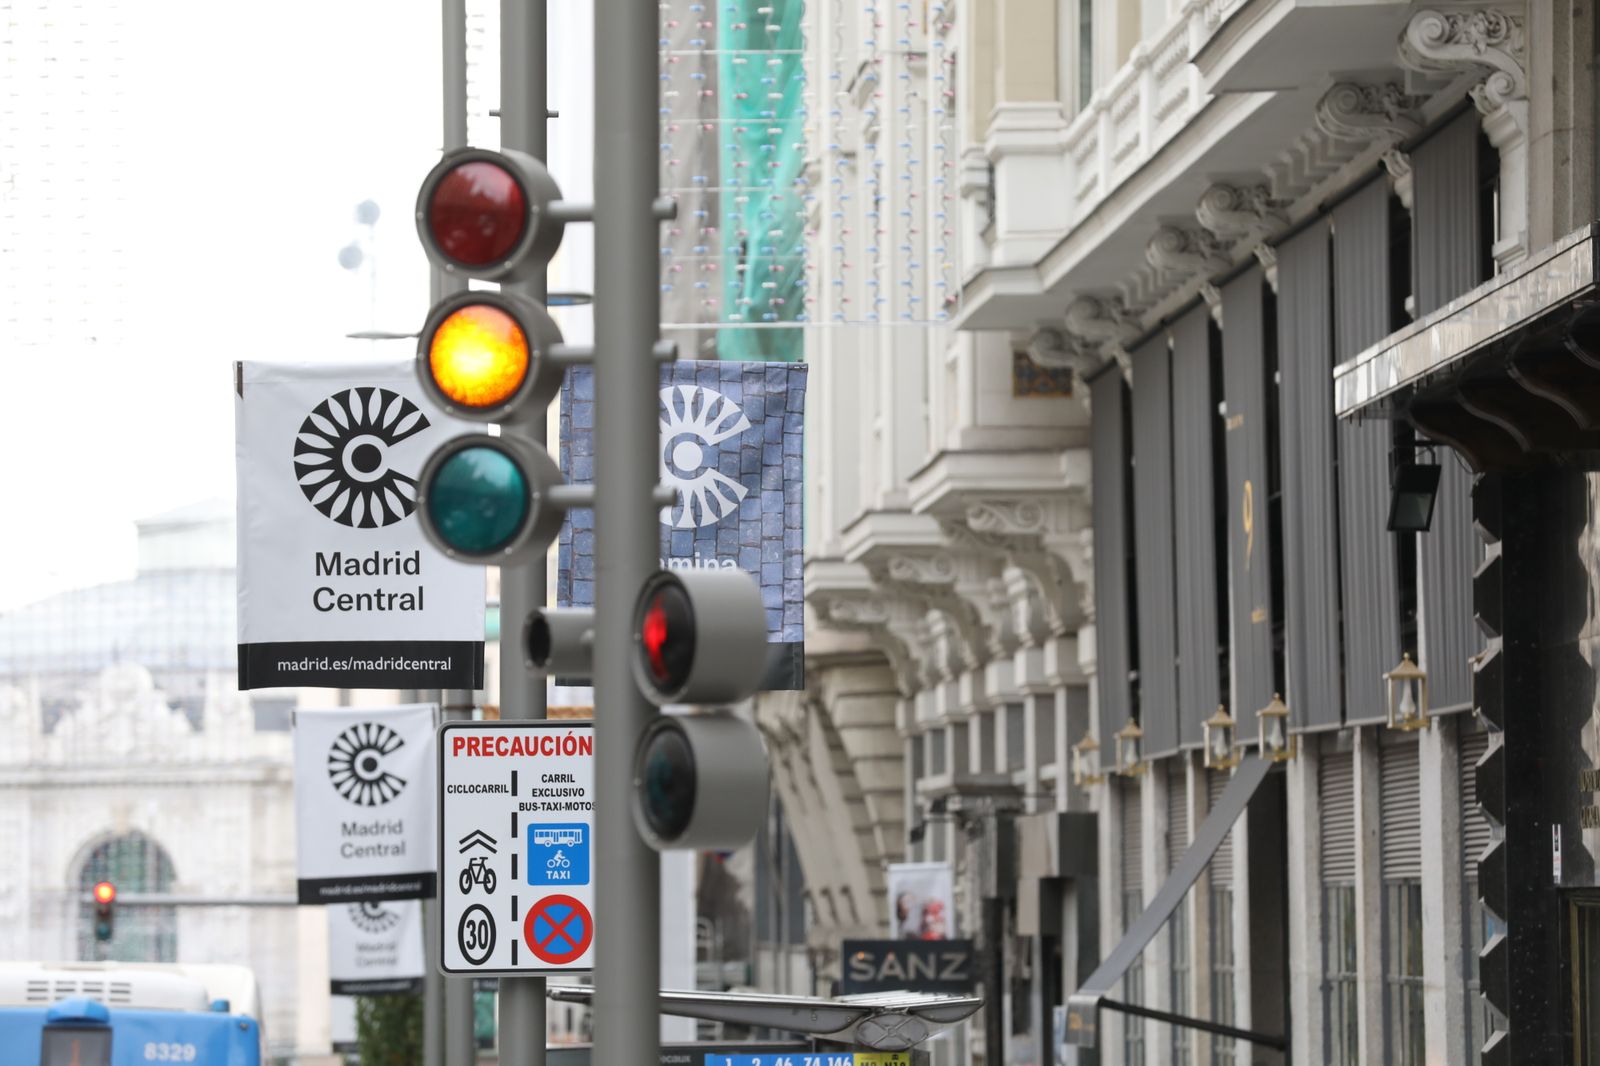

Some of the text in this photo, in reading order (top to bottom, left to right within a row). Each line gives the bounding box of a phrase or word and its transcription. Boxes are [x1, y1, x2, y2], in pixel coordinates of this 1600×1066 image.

[315, 550, 420, 576] Madrid
[313, 585, 424, 612] Central
[277, 656, 452, 672] madrid.es/madridcentral
[453, 731, 593, 757] PRECAUCIÓN
[541, 774, 576, 783] CARRIL
[447, 784, 510, 794] CICLOCARRIL
[532, 788, 585, 797] EXCLUSIVO
[341, 819, 404, 836] Madrid
[340, 840, 406, 858] Central
[545, 871, 571, 880] TAXI
[466, 919, 489, 950] 30
[848, 951, 969, 981] SANZ
[144, 1043, 196, 1061] 8329
